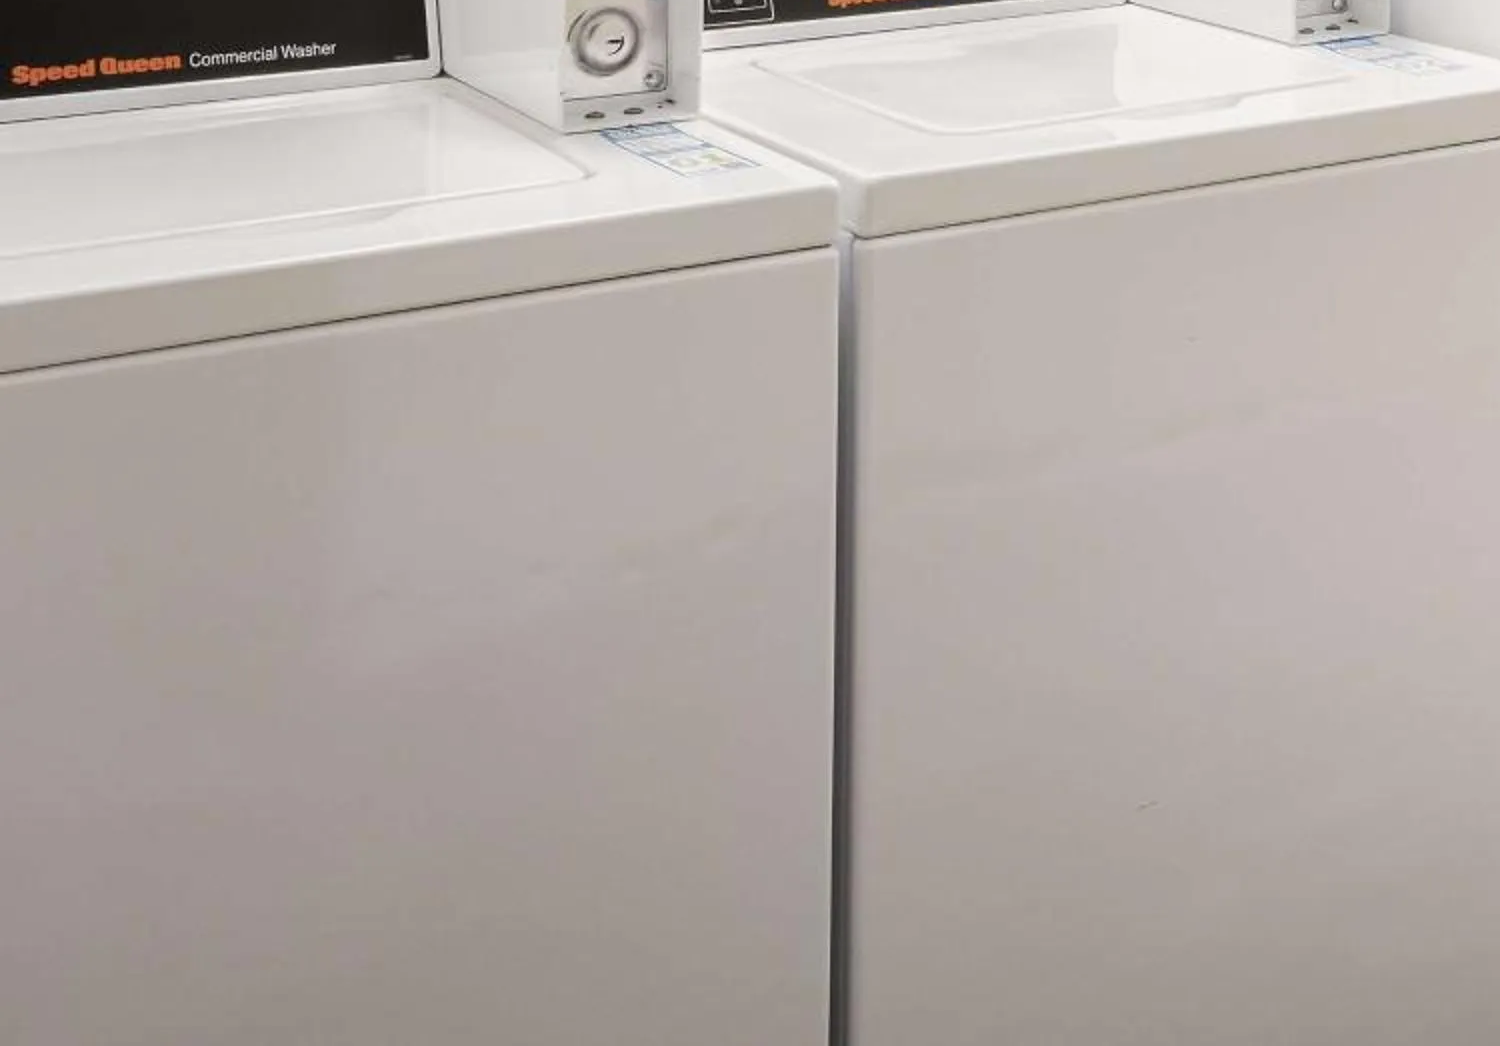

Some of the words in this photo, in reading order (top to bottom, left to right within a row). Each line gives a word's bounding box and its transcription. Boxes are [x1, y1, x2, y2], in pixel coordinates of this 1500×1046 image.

[11, 60, 96, 86] Speed
[99, 53, 183, 75] Queen
[188, 46, 278, 68] Commercial
[281, 42, 337, 58] Washer
